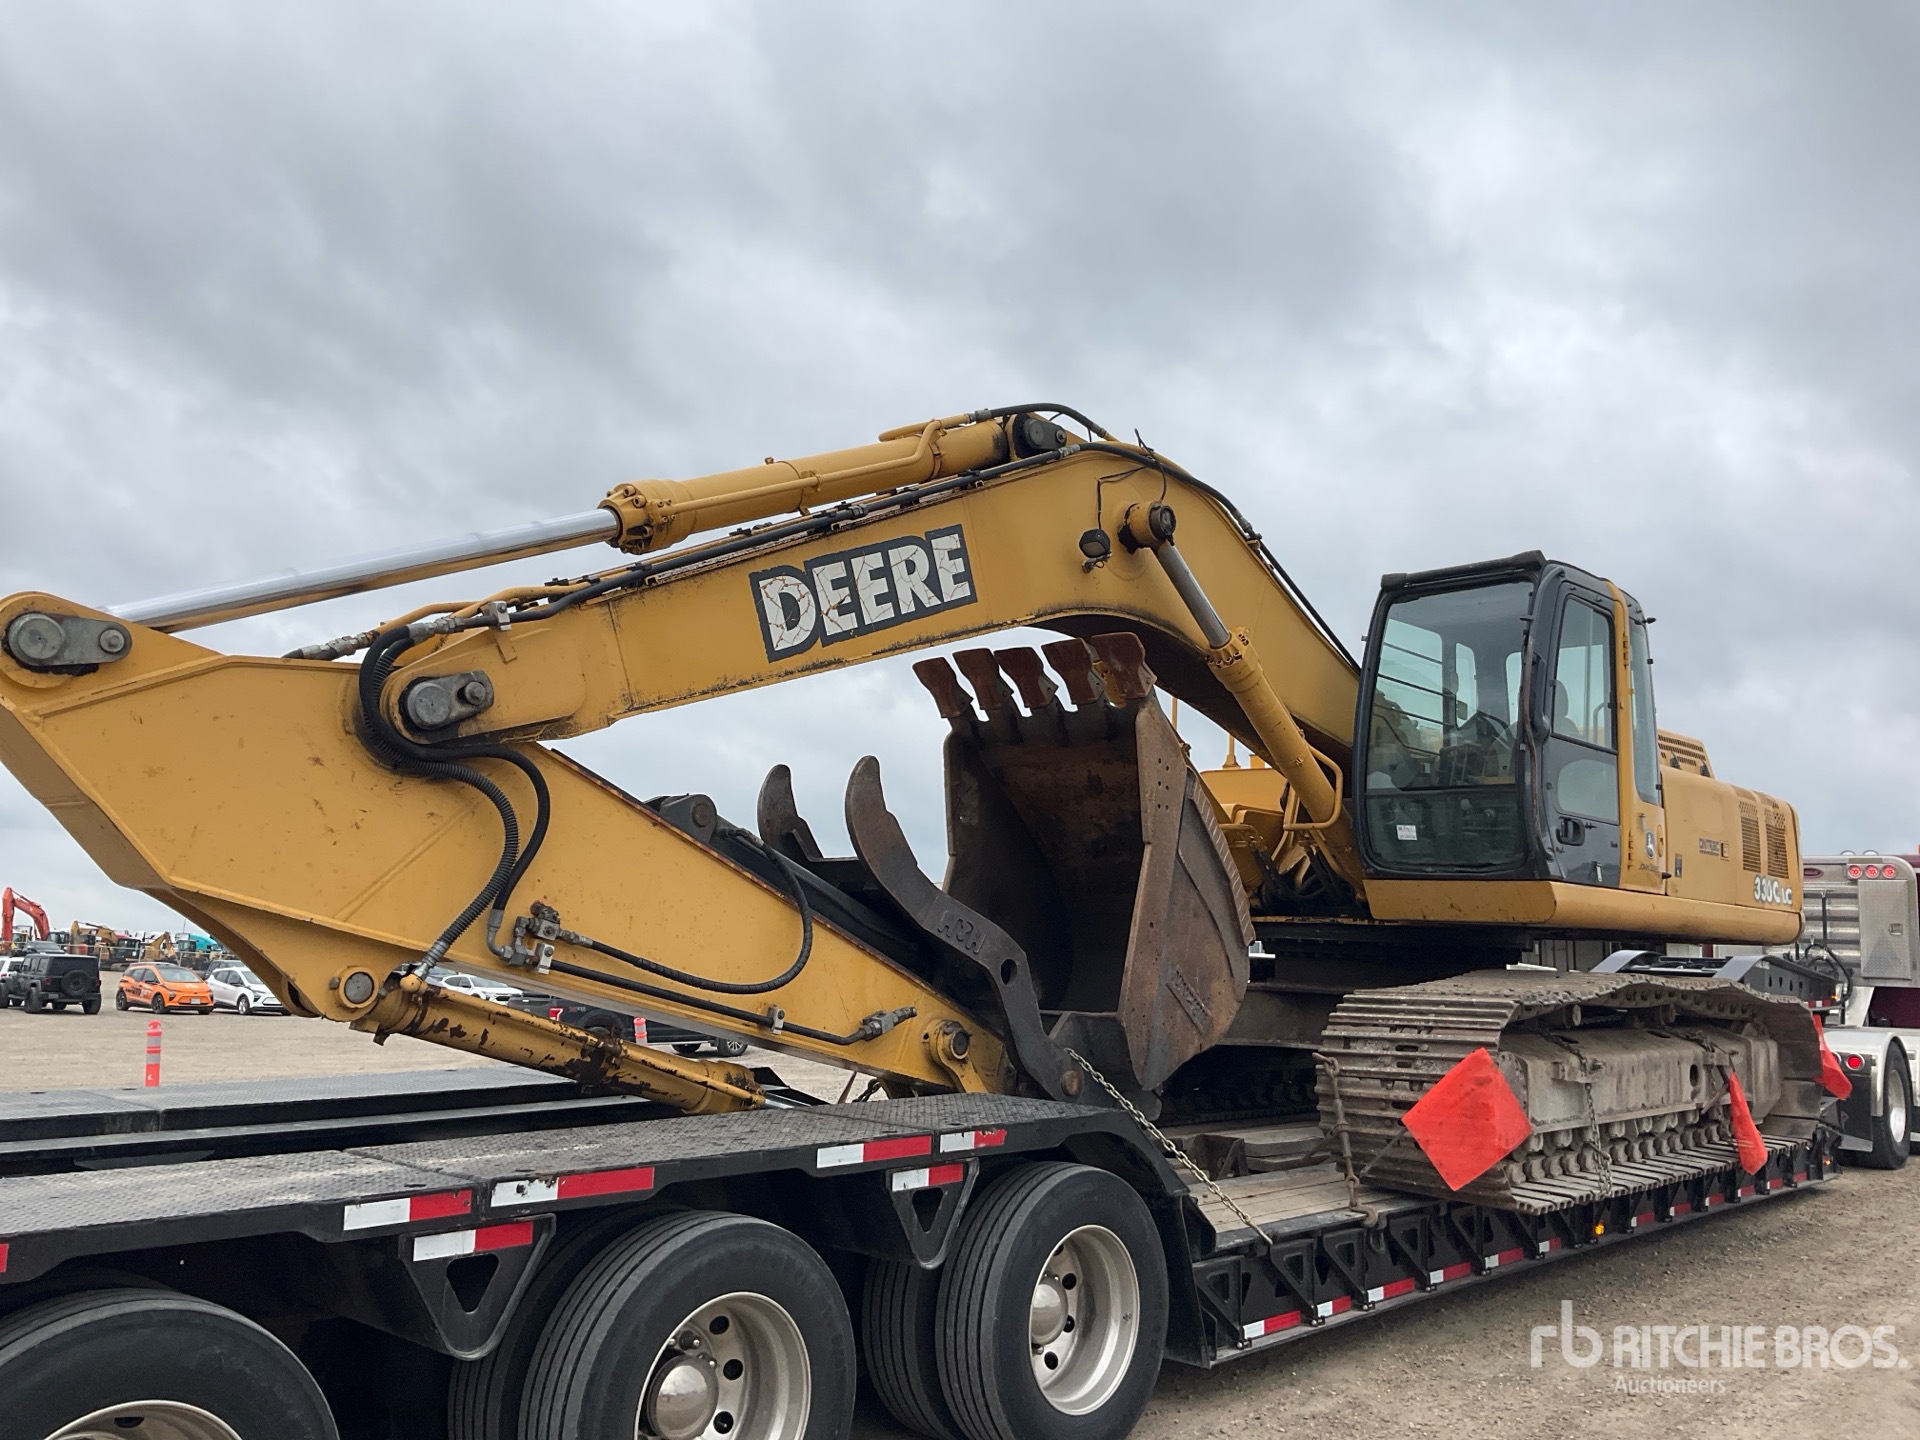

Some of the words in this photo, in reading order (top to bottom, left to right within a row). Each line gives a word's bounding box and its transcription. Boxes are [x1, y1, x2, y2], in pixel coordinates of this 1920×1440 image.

[759, 534, 970, 651] DEERE
[1754, 875, 1781, 904] 330C
[1781, 888, 1793, 905] LC
